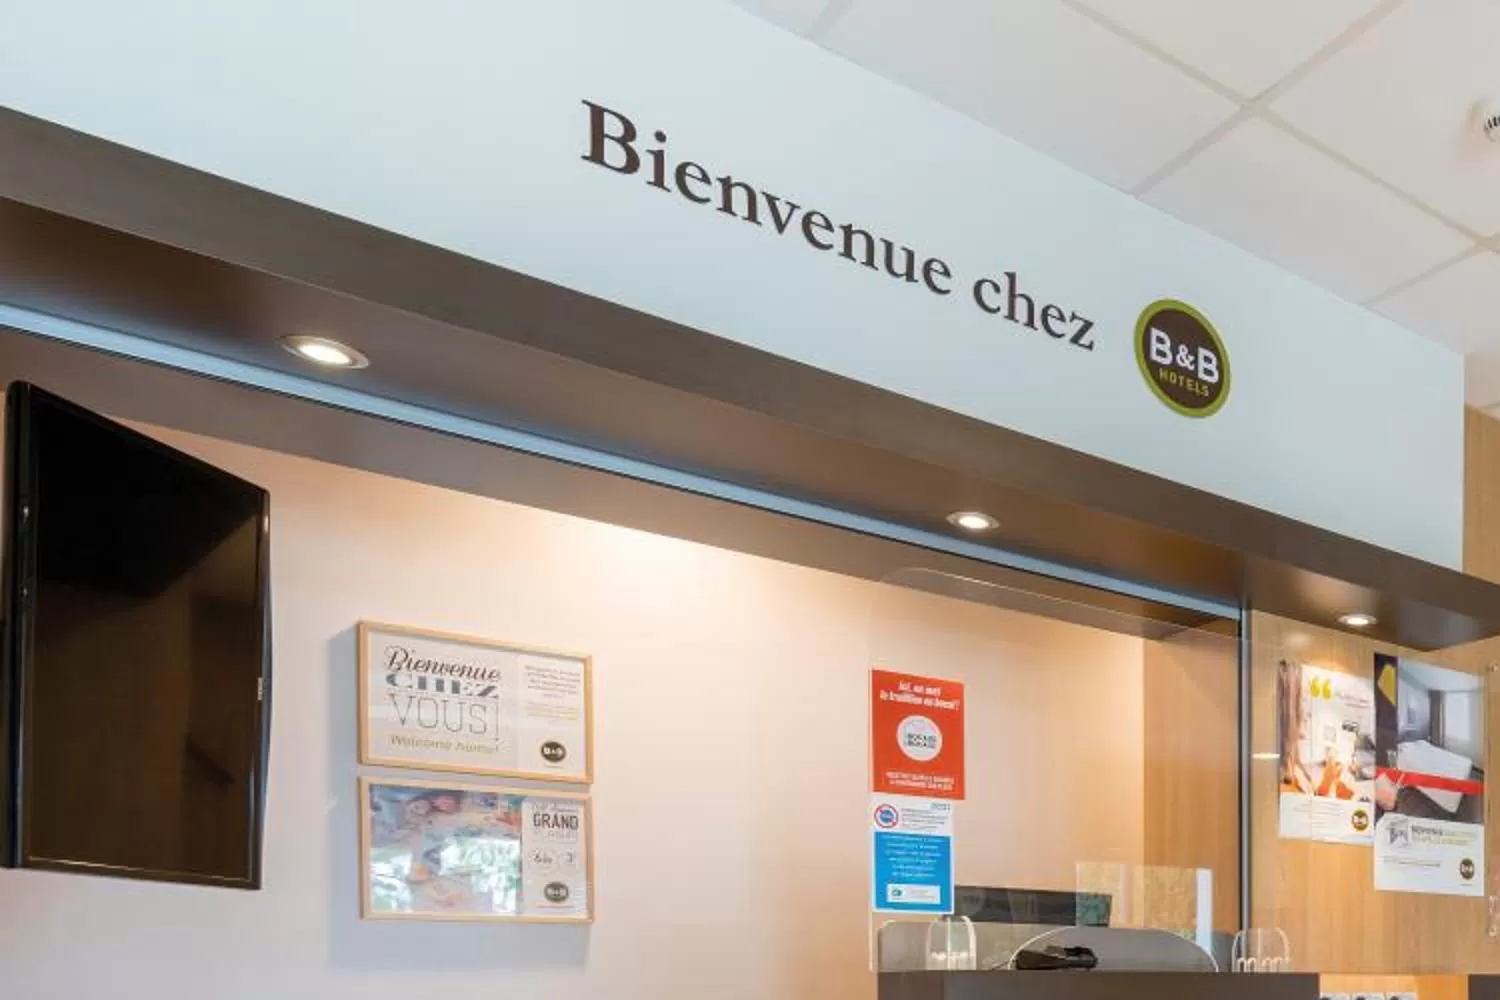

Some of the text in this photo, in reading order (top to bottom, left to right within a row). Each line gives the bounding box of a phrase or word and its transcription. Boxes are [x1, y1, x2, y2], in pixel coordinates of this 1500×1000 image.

[580, 99, 1095, 352] Bienvenue chez
[1149, 327, 1219, 384] B&B
[1159, 367, 1209, 397] HOTELS
[385, 645, 501, 681] Bienvenue
